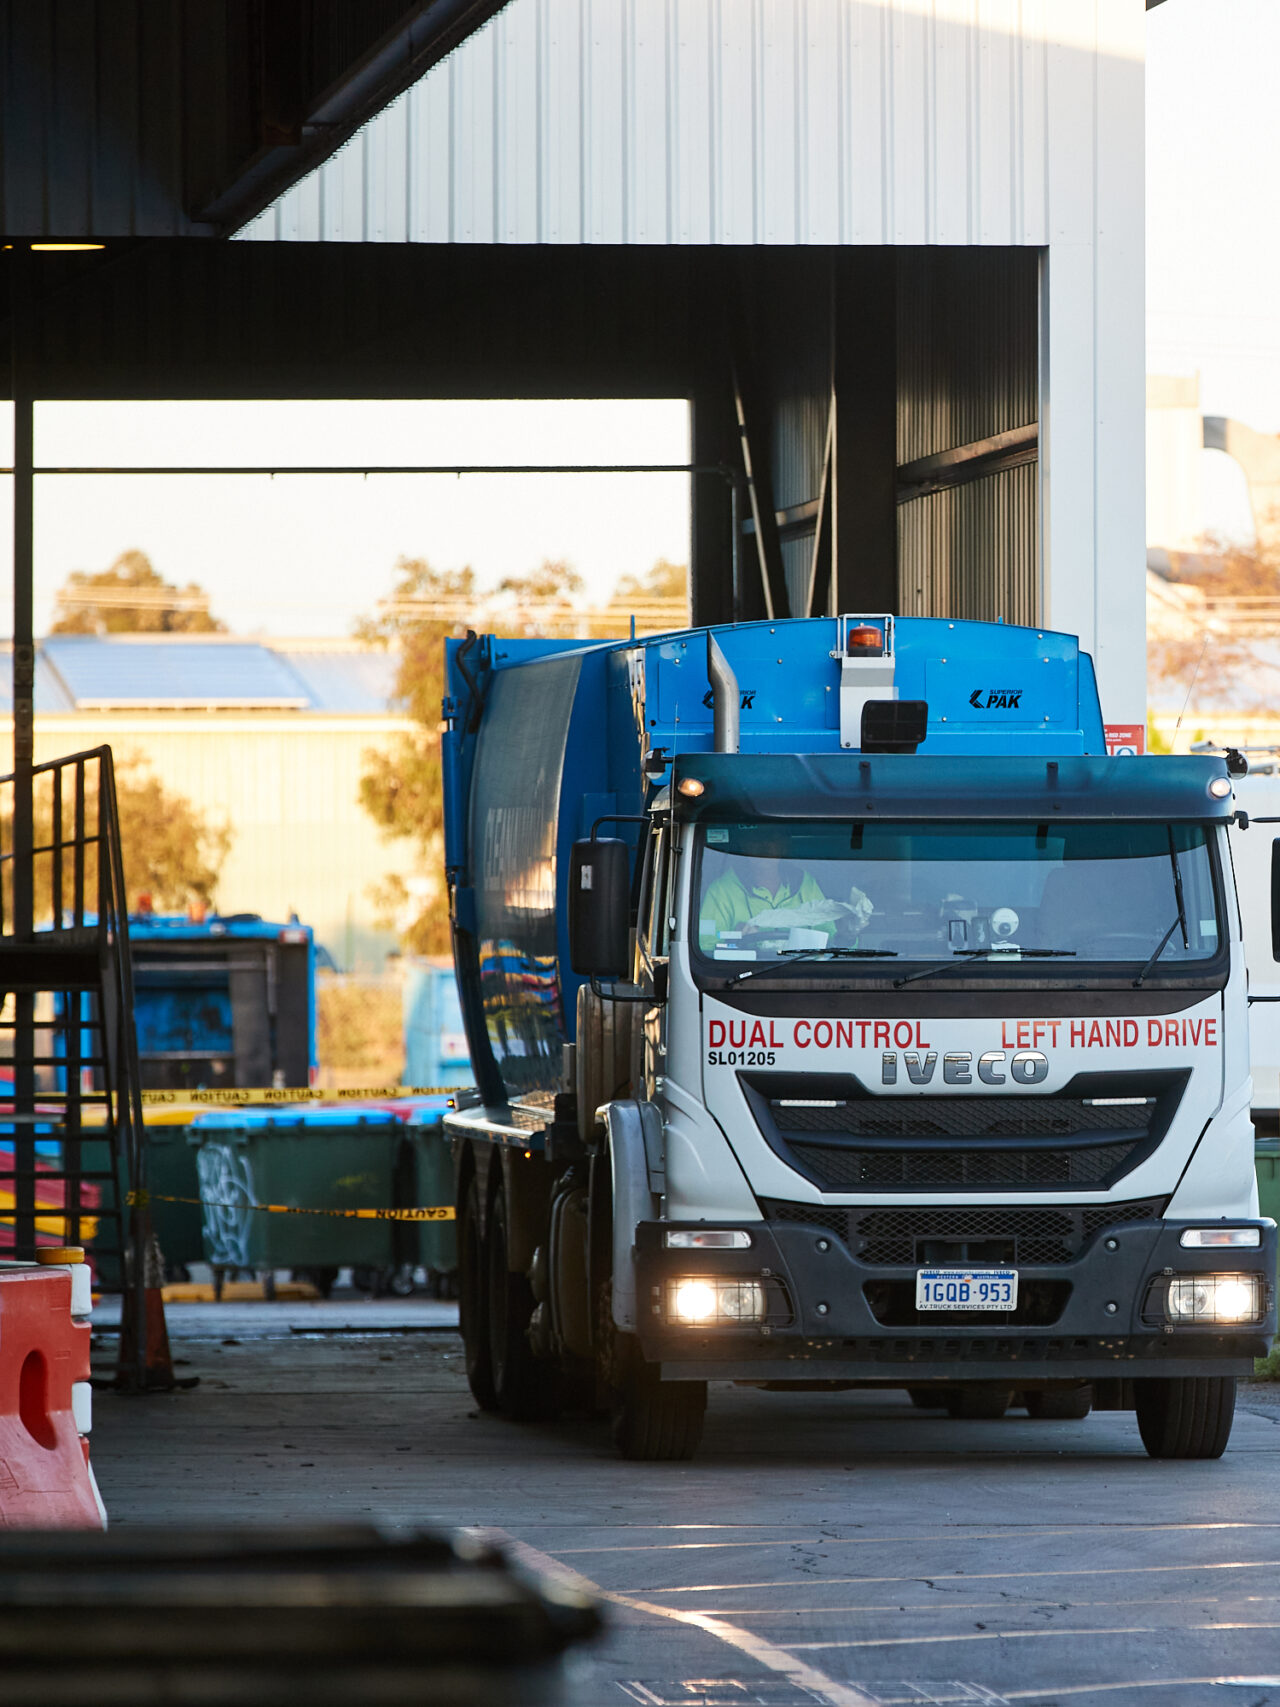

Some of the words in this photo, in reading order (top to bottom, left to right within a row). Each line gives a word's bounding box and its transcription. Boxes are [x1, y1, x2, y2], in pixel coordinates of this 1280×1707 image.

[986, 695, 1021, 708] PAK
[709, 1020, 784, 1048] DUAL
[793, 1020, 931, 1049] CONTROL
[1001, 1021, 1062, 1049] LEFT
[1070, 1020, 1139, 1048] HAND
[1147, 1018, 1217, 1047] DRIVE
[708, 1051, 776, 1066] SL01205
[881, 1051, 1049, 1085] IVECO
